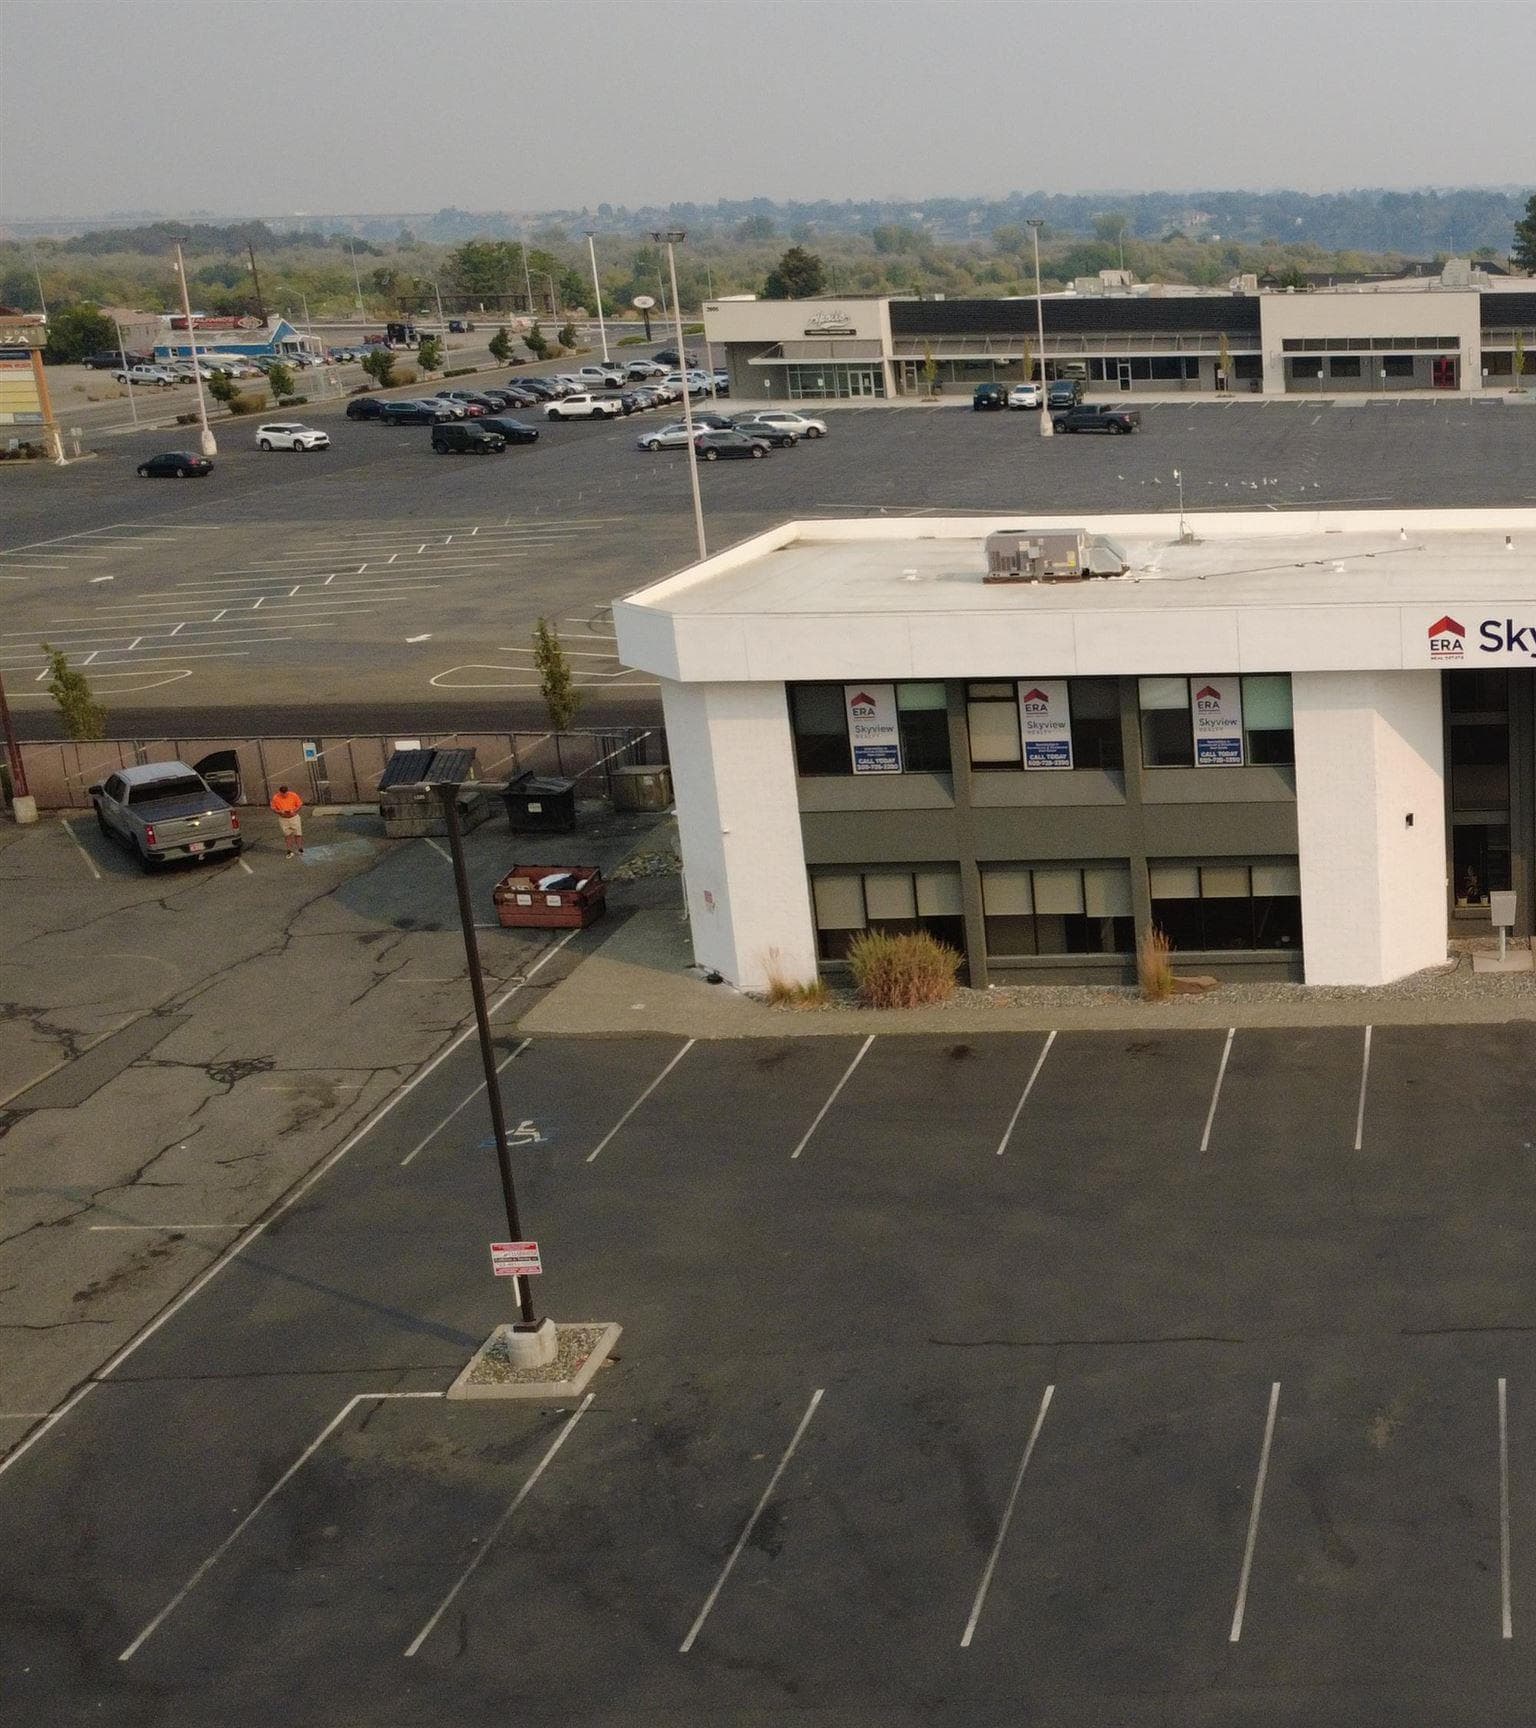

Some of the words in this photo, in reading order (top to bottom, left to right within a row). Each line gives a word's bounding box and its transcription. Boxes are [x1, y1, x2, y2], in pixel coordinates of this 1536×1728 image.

[0, 335, 29, 343] ZA
[1430, 639, 1464, 651] ERA
[1025, 704, 1048, 712] ERA
[1198, 701, 1220, 709] ERA
[853, 708, 875, 716] ERA
[1027, 720, 1066, 730] Skyview
[1199, 718, 1238, 728] Skyview
[855, 725, 894, 734] Skyview
